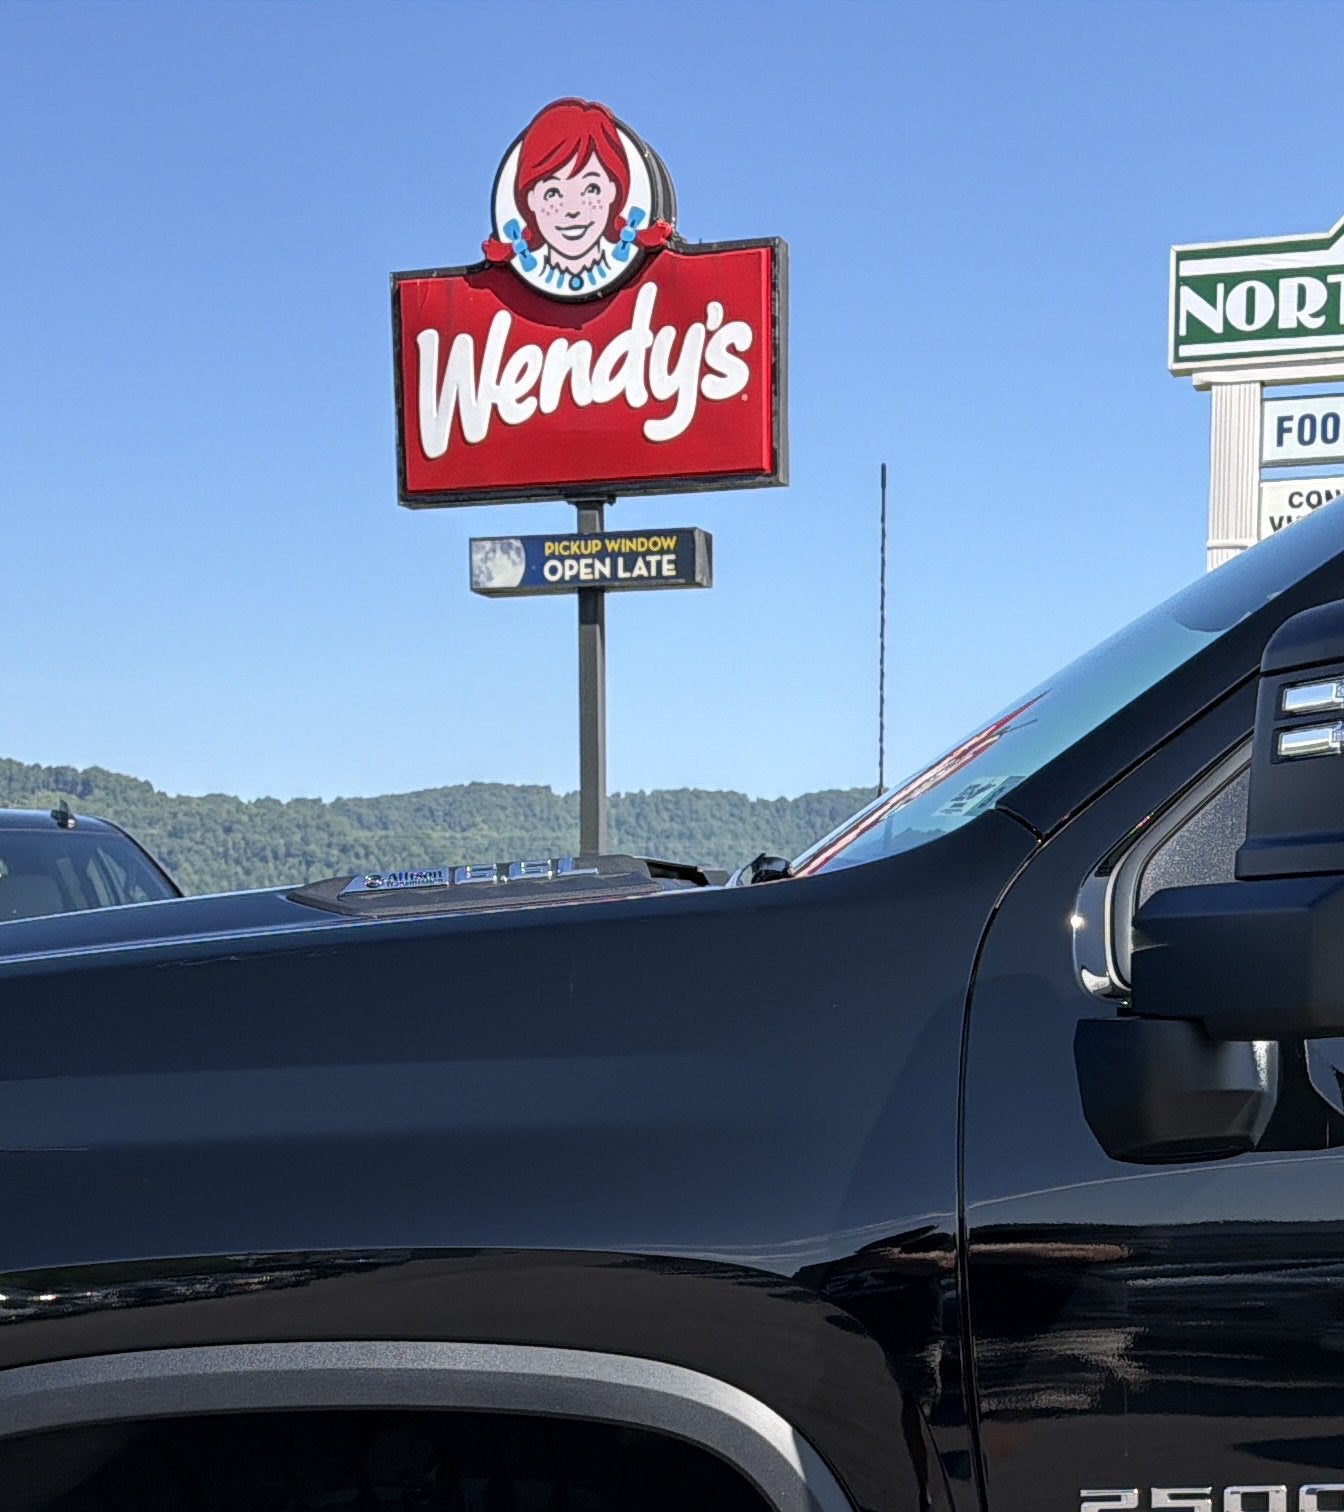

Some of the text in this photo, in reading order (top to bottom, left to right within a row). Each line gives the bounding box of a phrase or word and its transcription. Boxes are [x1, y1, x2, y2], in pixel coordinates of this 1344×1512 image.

[416, 281, 753, 460] Wendy's
[544, 535, 678, 556] PICKUP WINDOW
[543, 554, 677, 581] OPEN LATE
